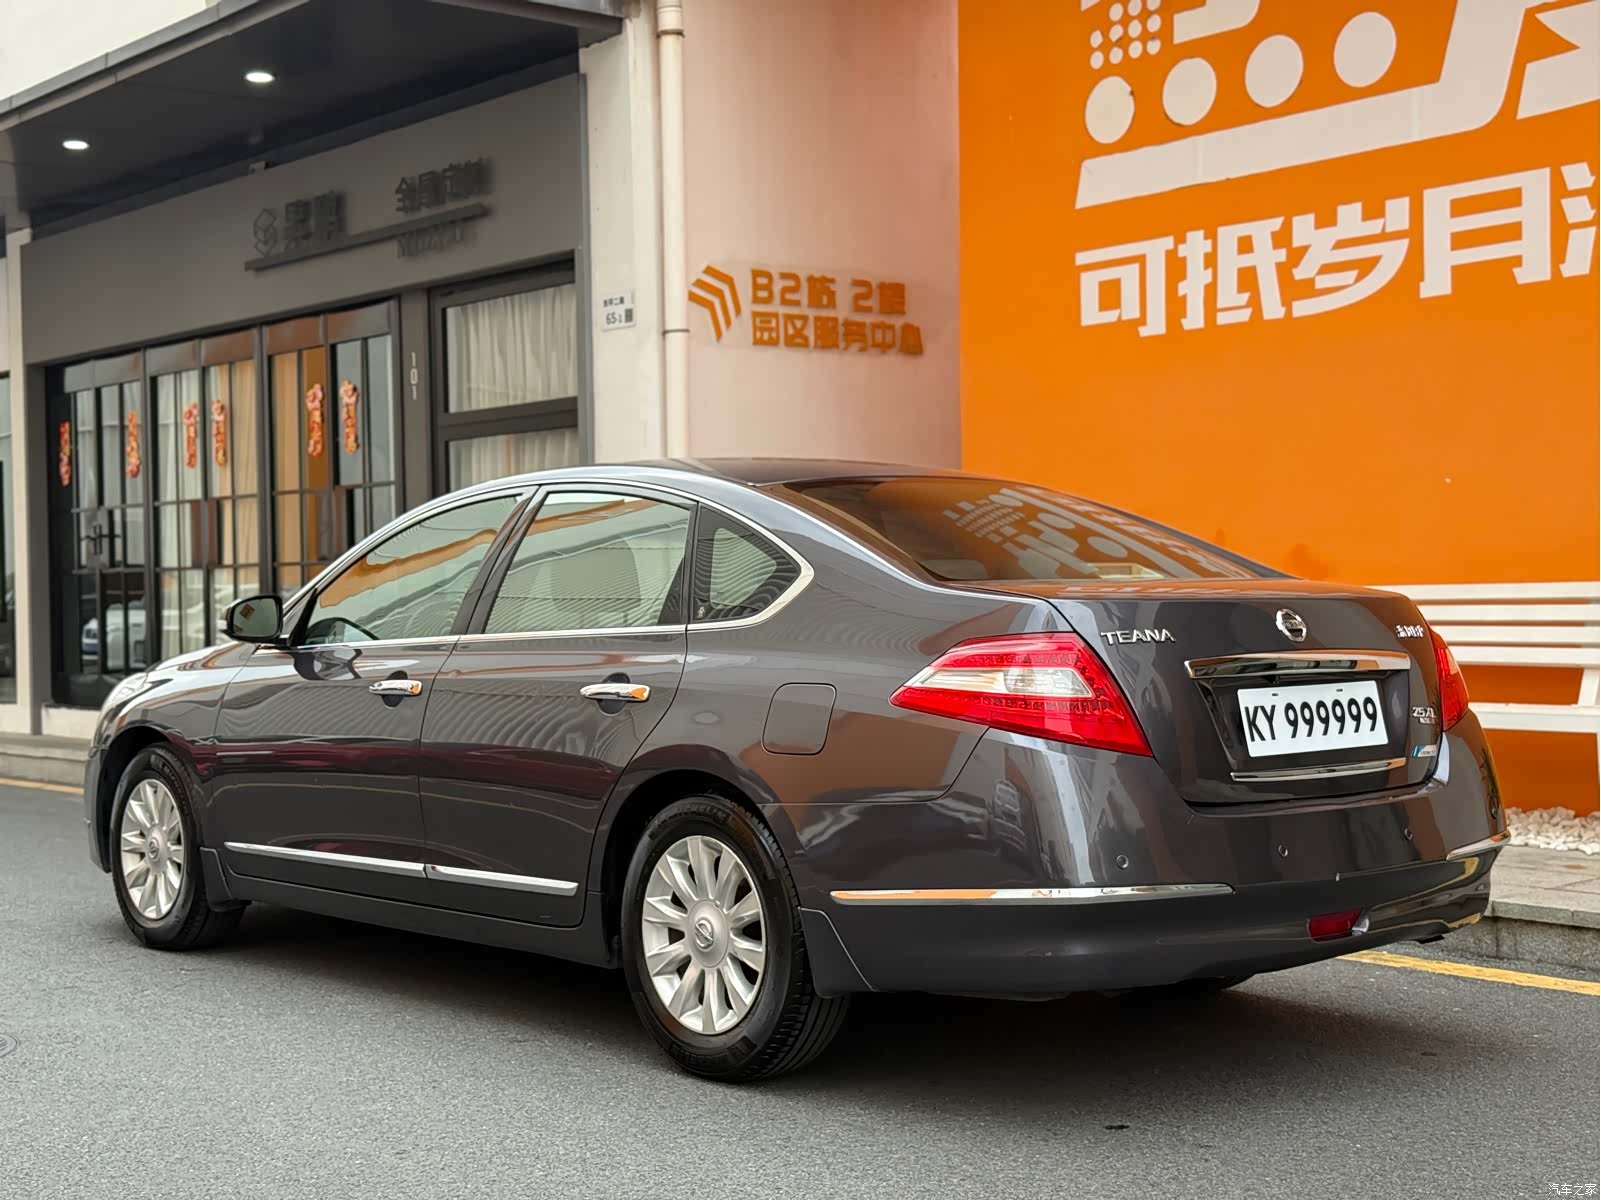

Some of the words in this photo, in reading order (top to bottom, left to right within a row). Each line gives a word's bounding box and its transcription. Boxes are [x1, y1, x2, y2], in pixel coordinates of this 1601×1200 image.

[751, 310, 924, 355] 园区服务中心
[1100, 628, 1176, 645] TEANA
[1244, 704, 1277, 742] KY
[1284, 696, 1378, 739] 999999
